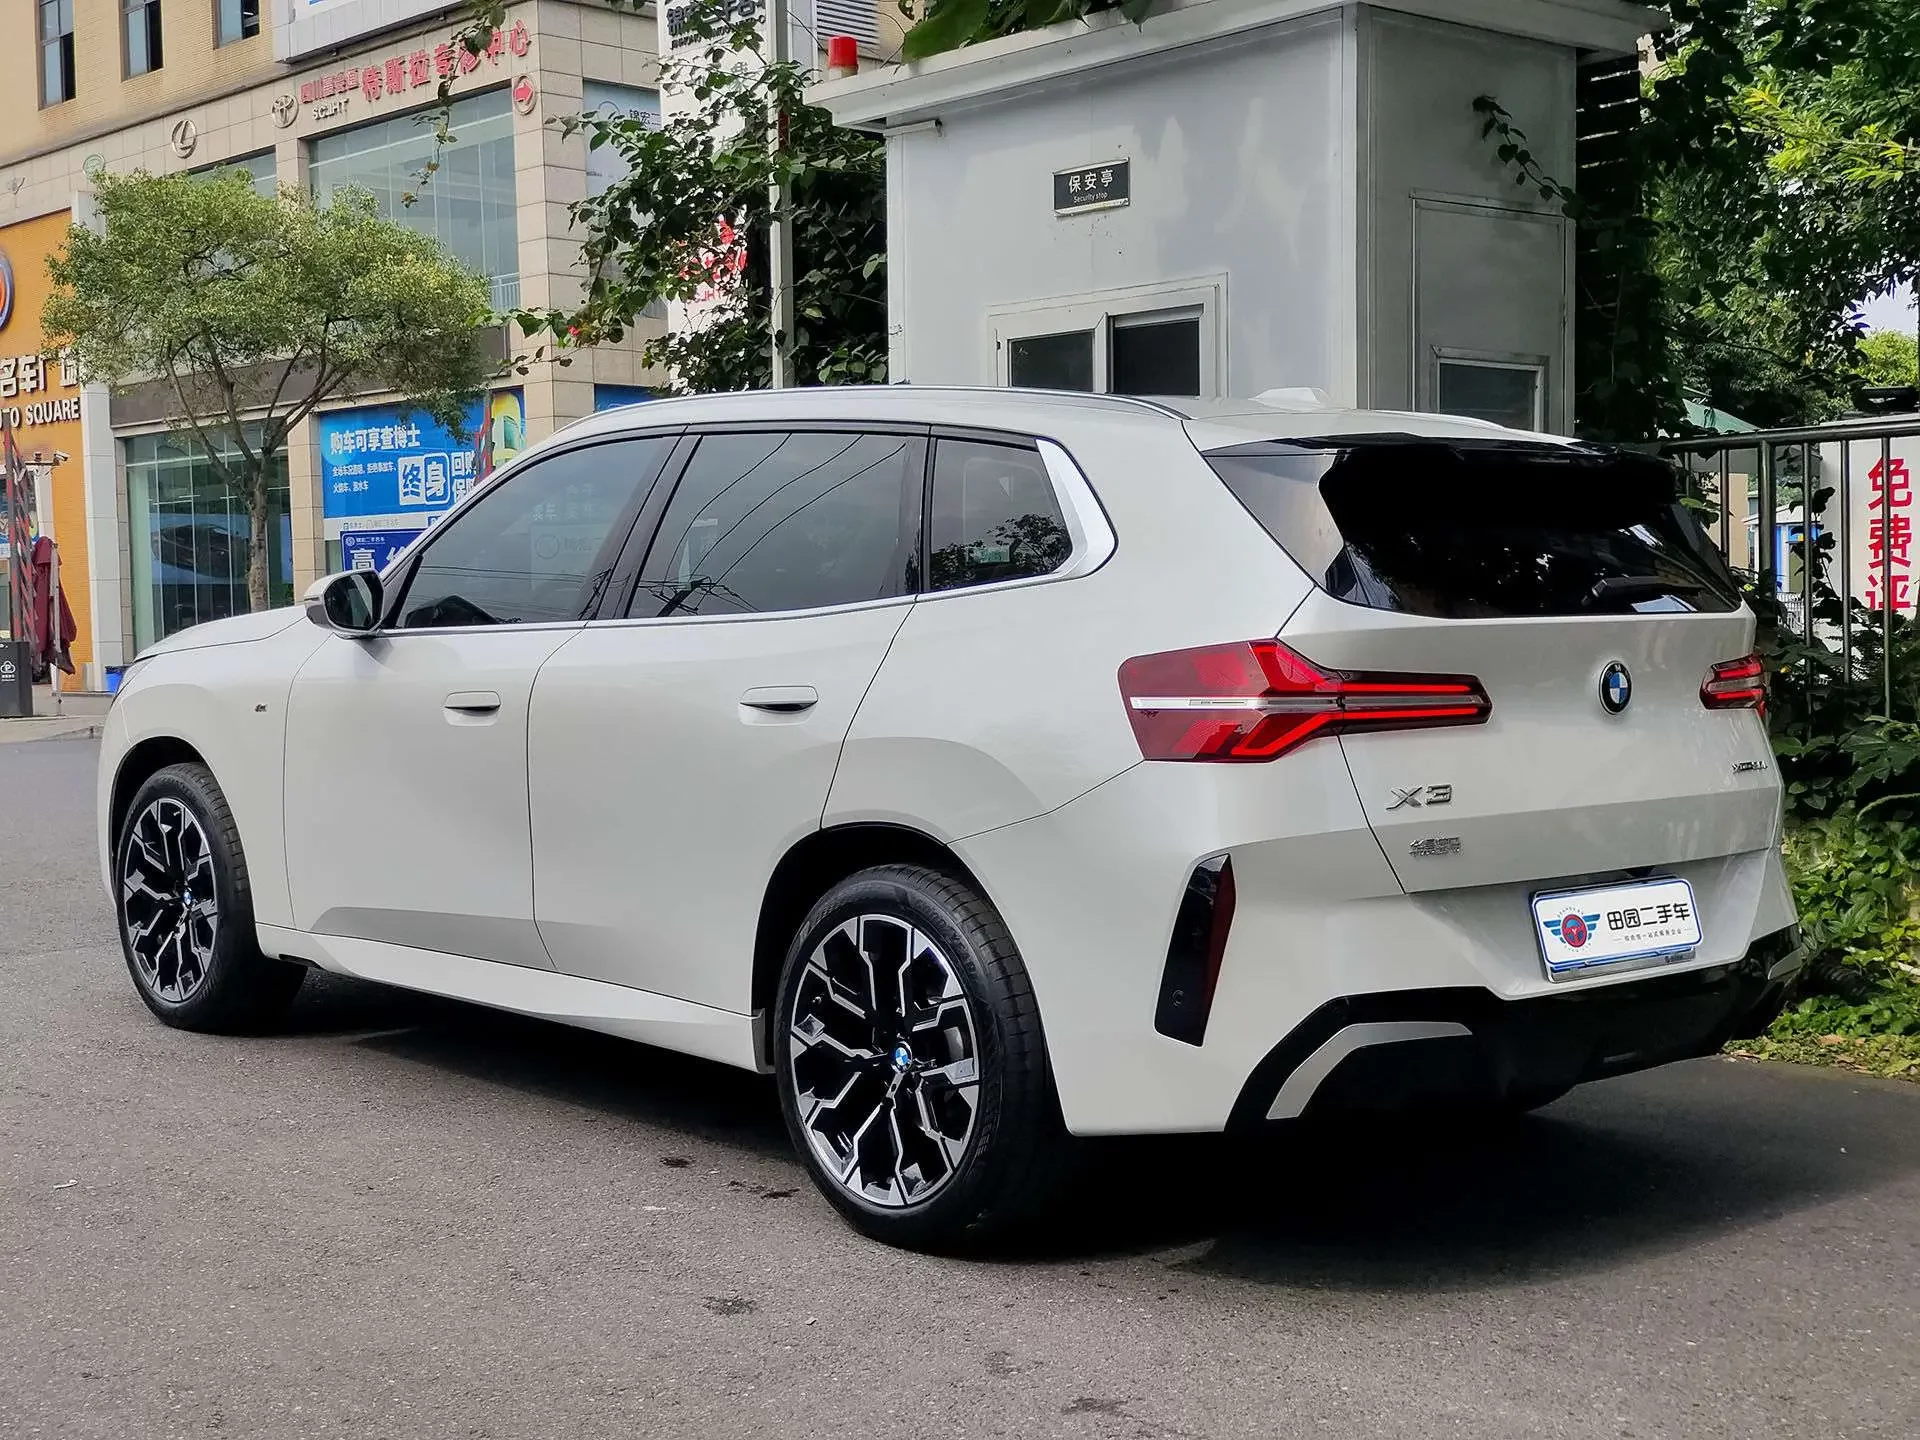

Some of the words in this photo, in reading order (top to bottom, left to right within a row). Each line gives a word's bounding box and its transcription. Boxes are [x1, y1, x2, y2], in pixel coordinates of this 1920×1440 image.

[1069, 169, 1114, 194] 保安亭
[1074, 194, 1095, 203] Security
[26, 398, 80, 426] SQUARE
[331, 423, 421, 455] 购车可享查博士
[402, 461, 446, 498] 终身
[1386, 783, 1452, 811] X3
[1607, 903, 1691, 931] 田园二手车
